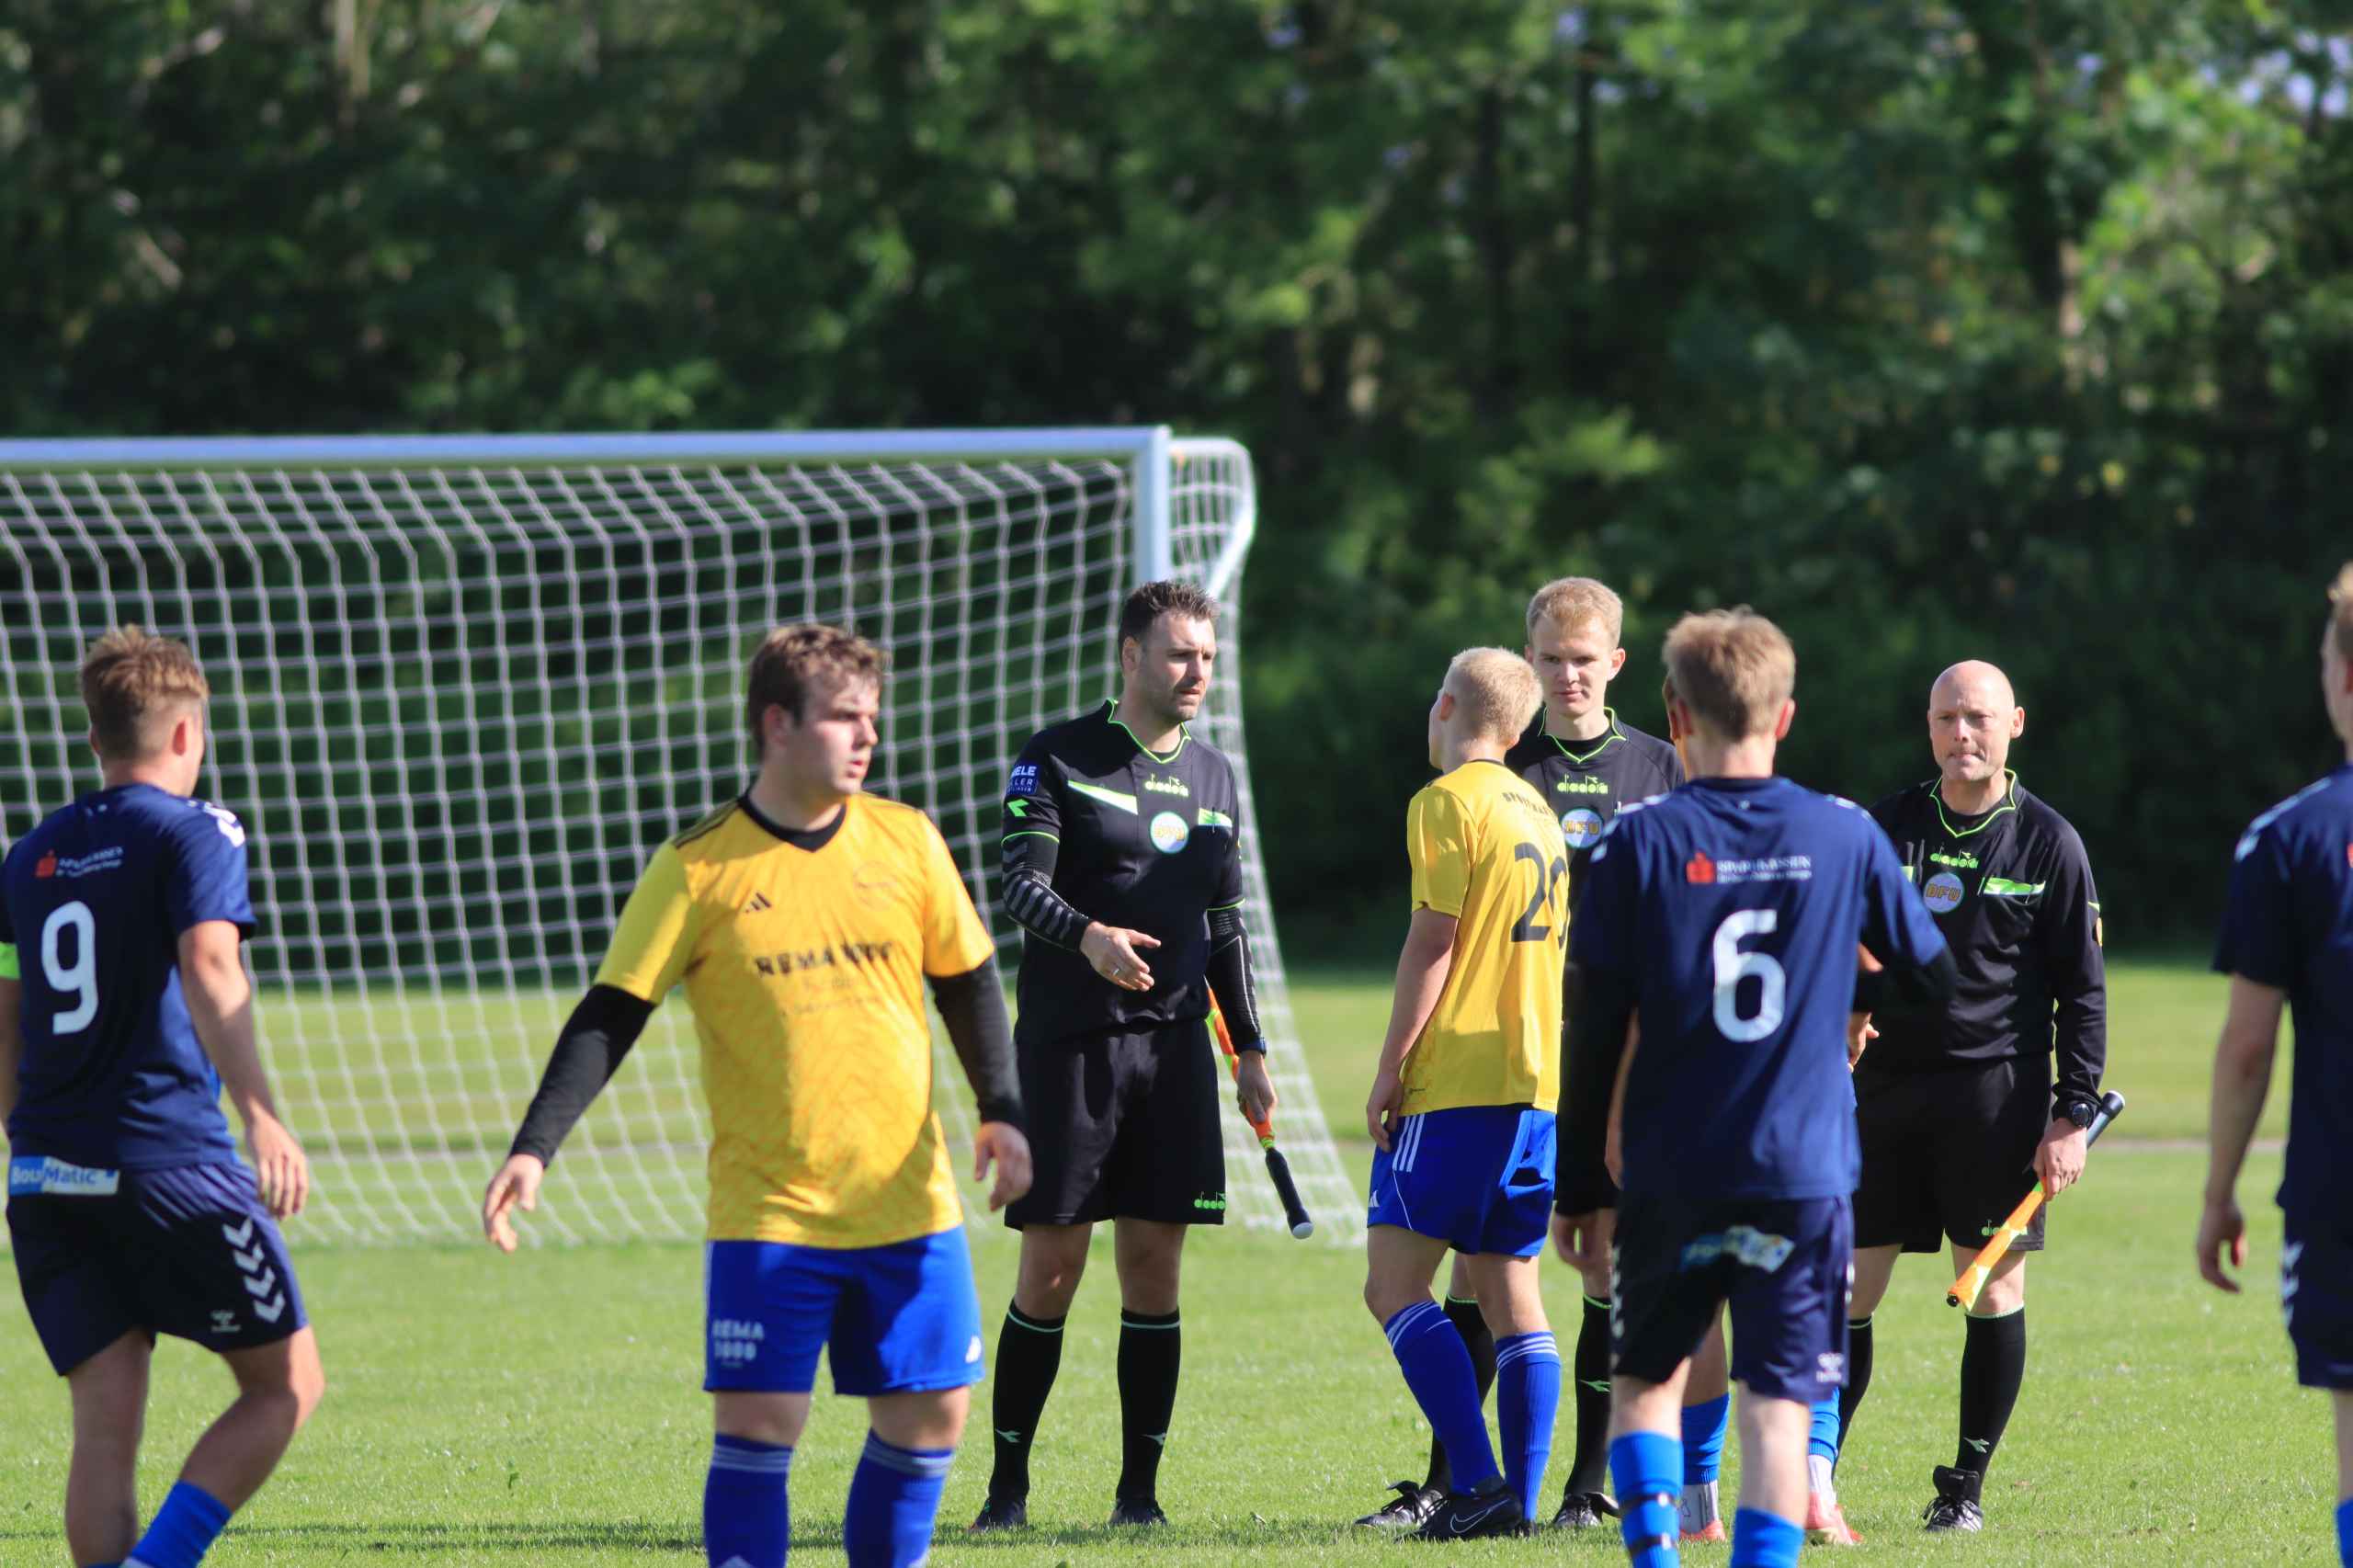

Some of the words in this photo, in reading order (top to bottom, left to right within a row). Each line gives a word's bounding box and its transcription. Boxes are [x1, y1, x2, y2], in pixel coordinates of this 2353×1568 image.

[41, 900, 98, 1035] 9
[1712, 909, 1786, 1042] 6
[1194, 1191, 1226, 1210] diado
